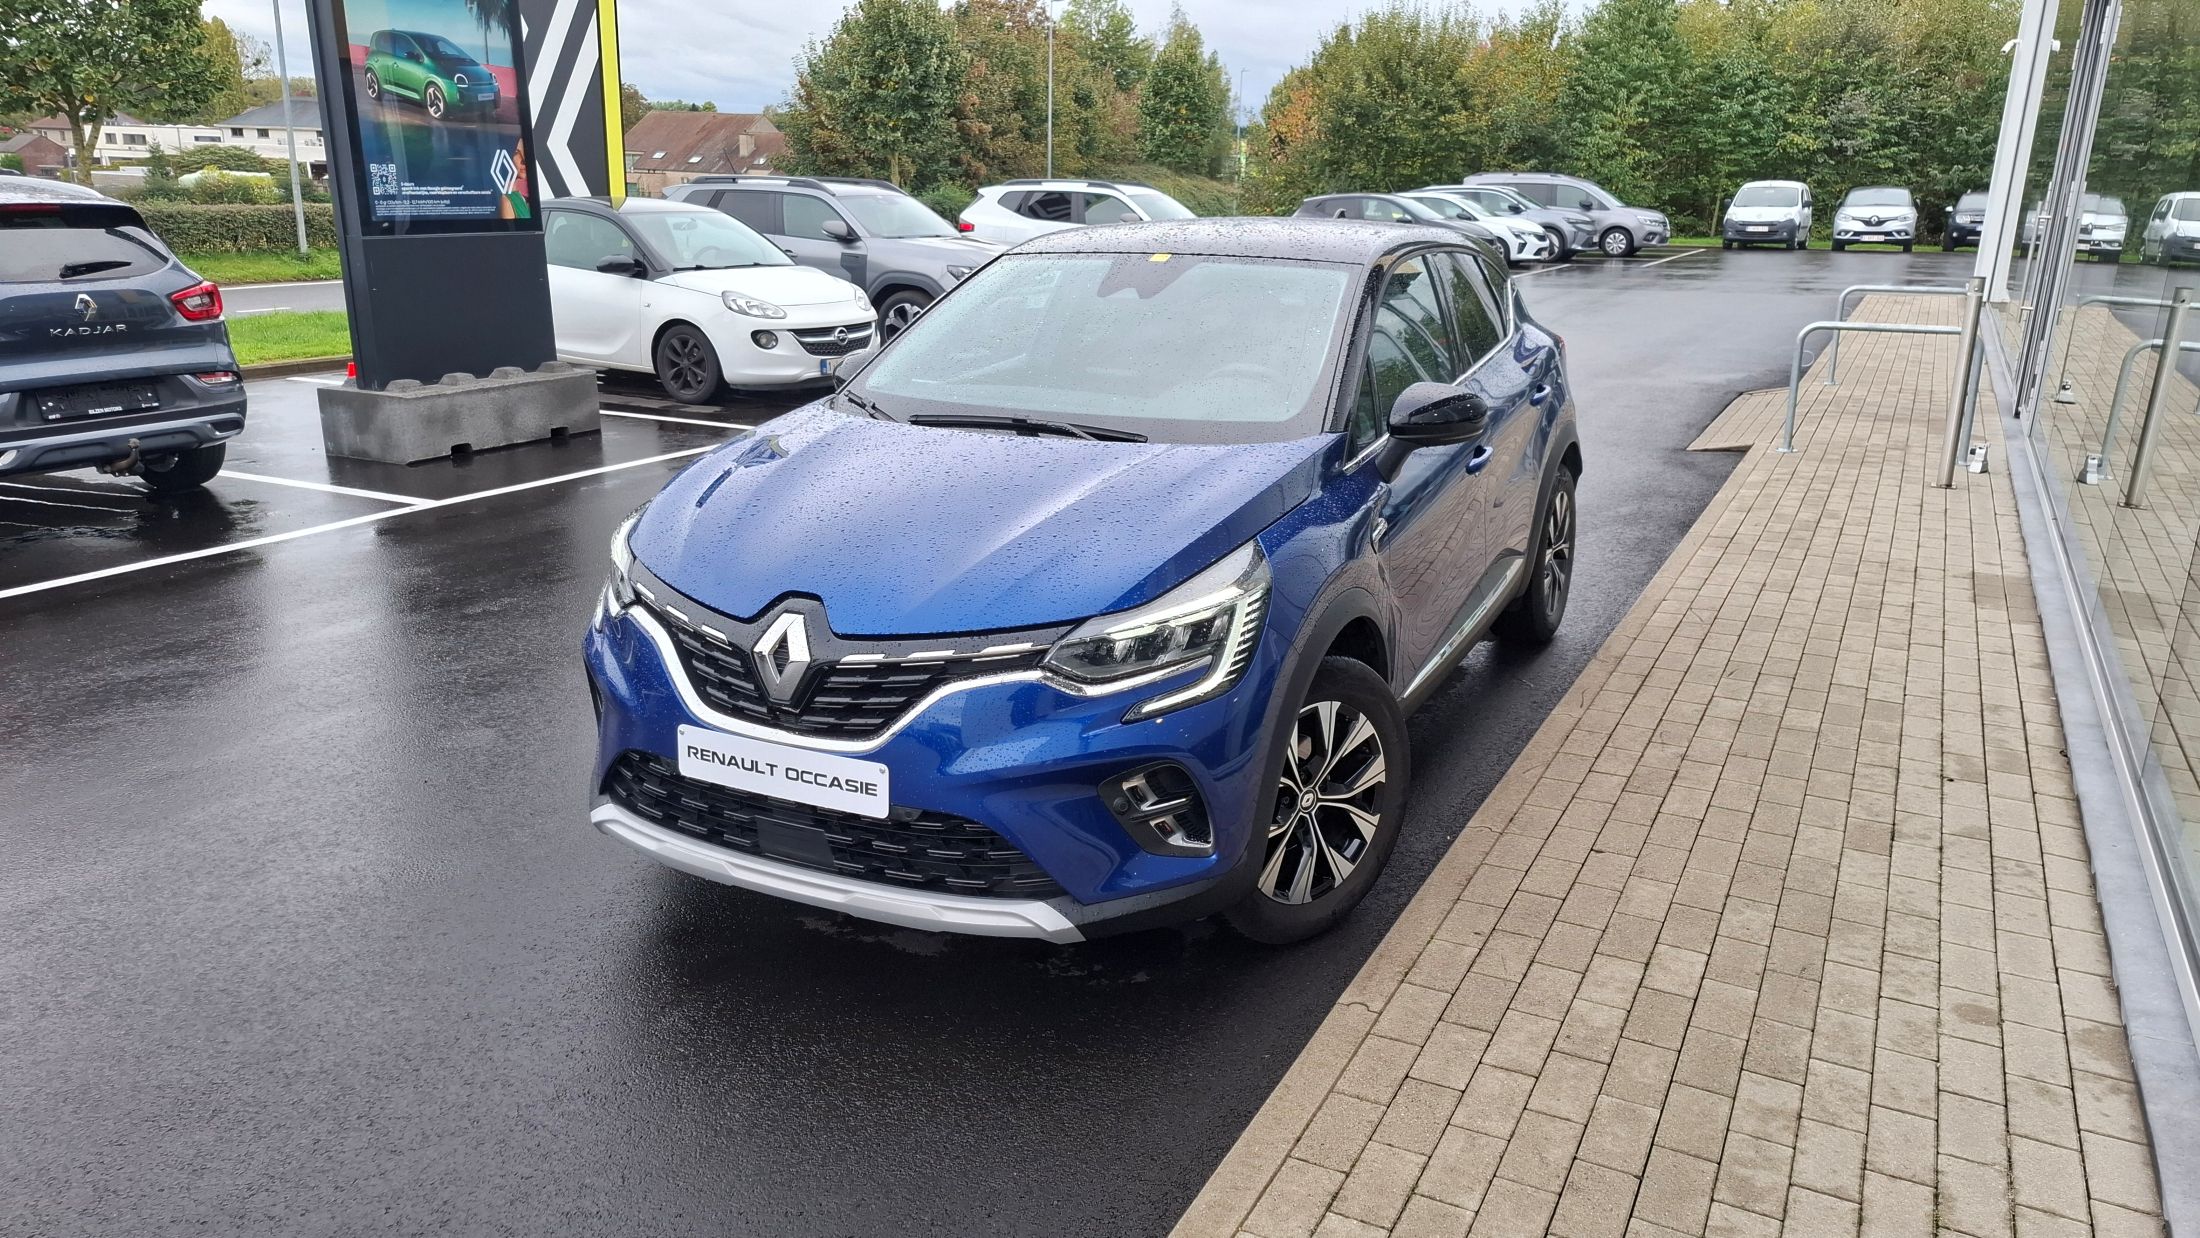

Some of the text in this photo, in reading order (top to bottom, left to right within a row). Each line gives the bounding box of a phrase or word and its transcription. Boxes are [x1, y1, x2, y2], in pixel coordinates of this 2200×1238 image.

[49, 324, 128, 337] KADJAR
[687, 745, 878, 797] RENAULT OCCASIE
